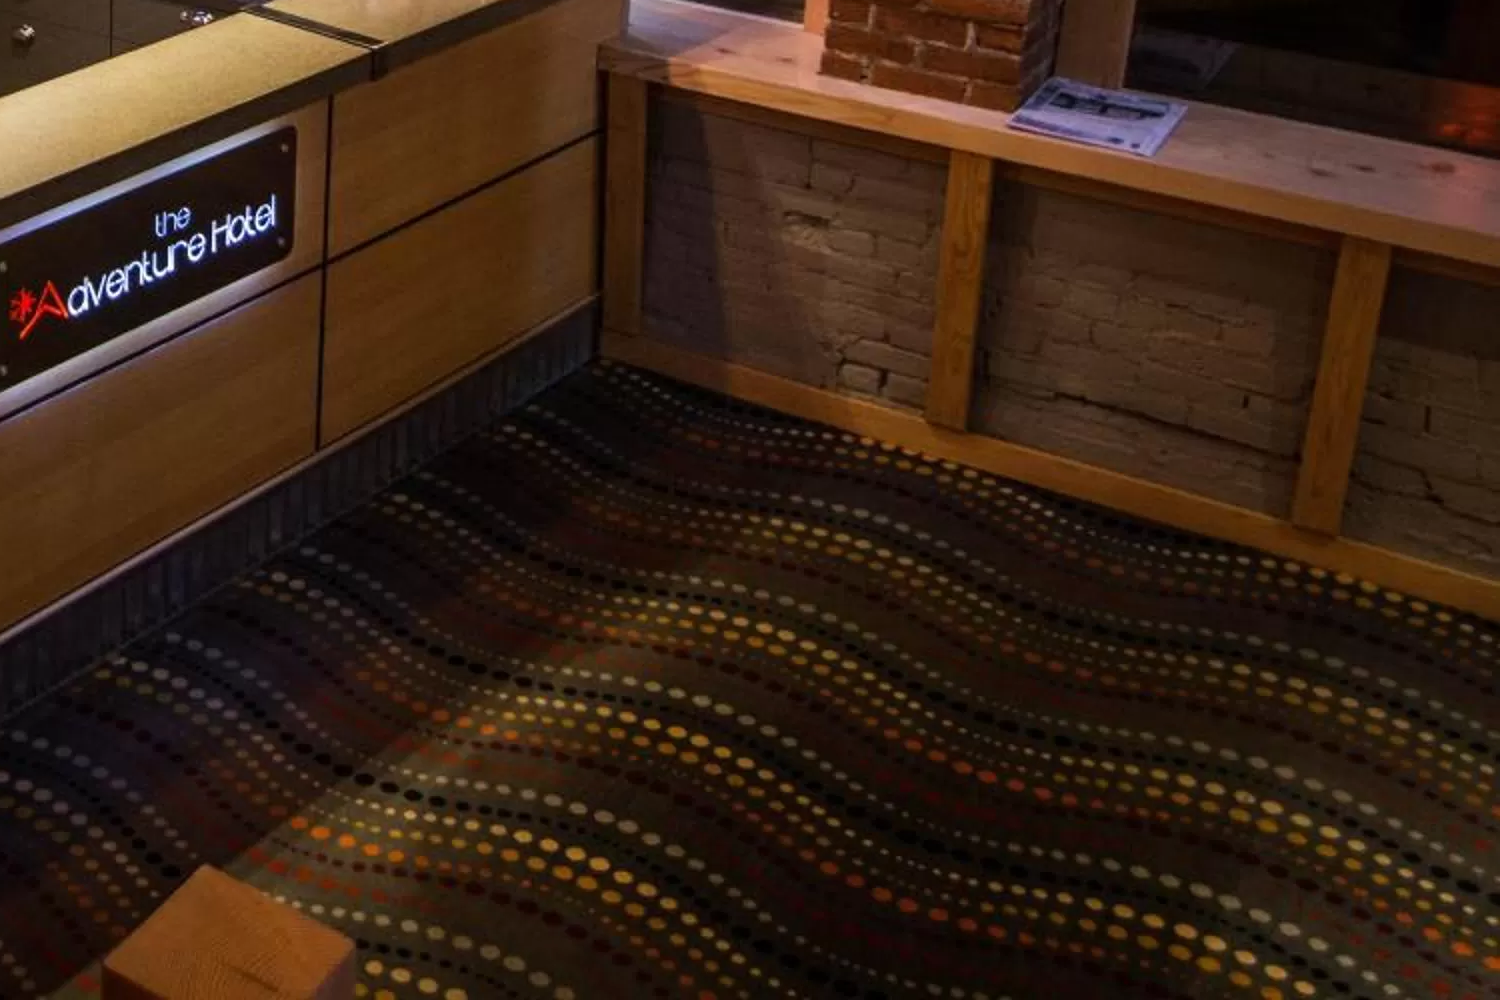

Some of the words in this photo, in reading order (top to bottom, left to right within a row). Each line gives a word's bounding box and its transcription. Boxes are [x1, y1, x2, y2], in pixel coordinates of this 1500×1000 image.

[154, 206, 192, 238] the
[18, 232, 207, 342] Adventure
[210, 193, 277, 253] Hotel
